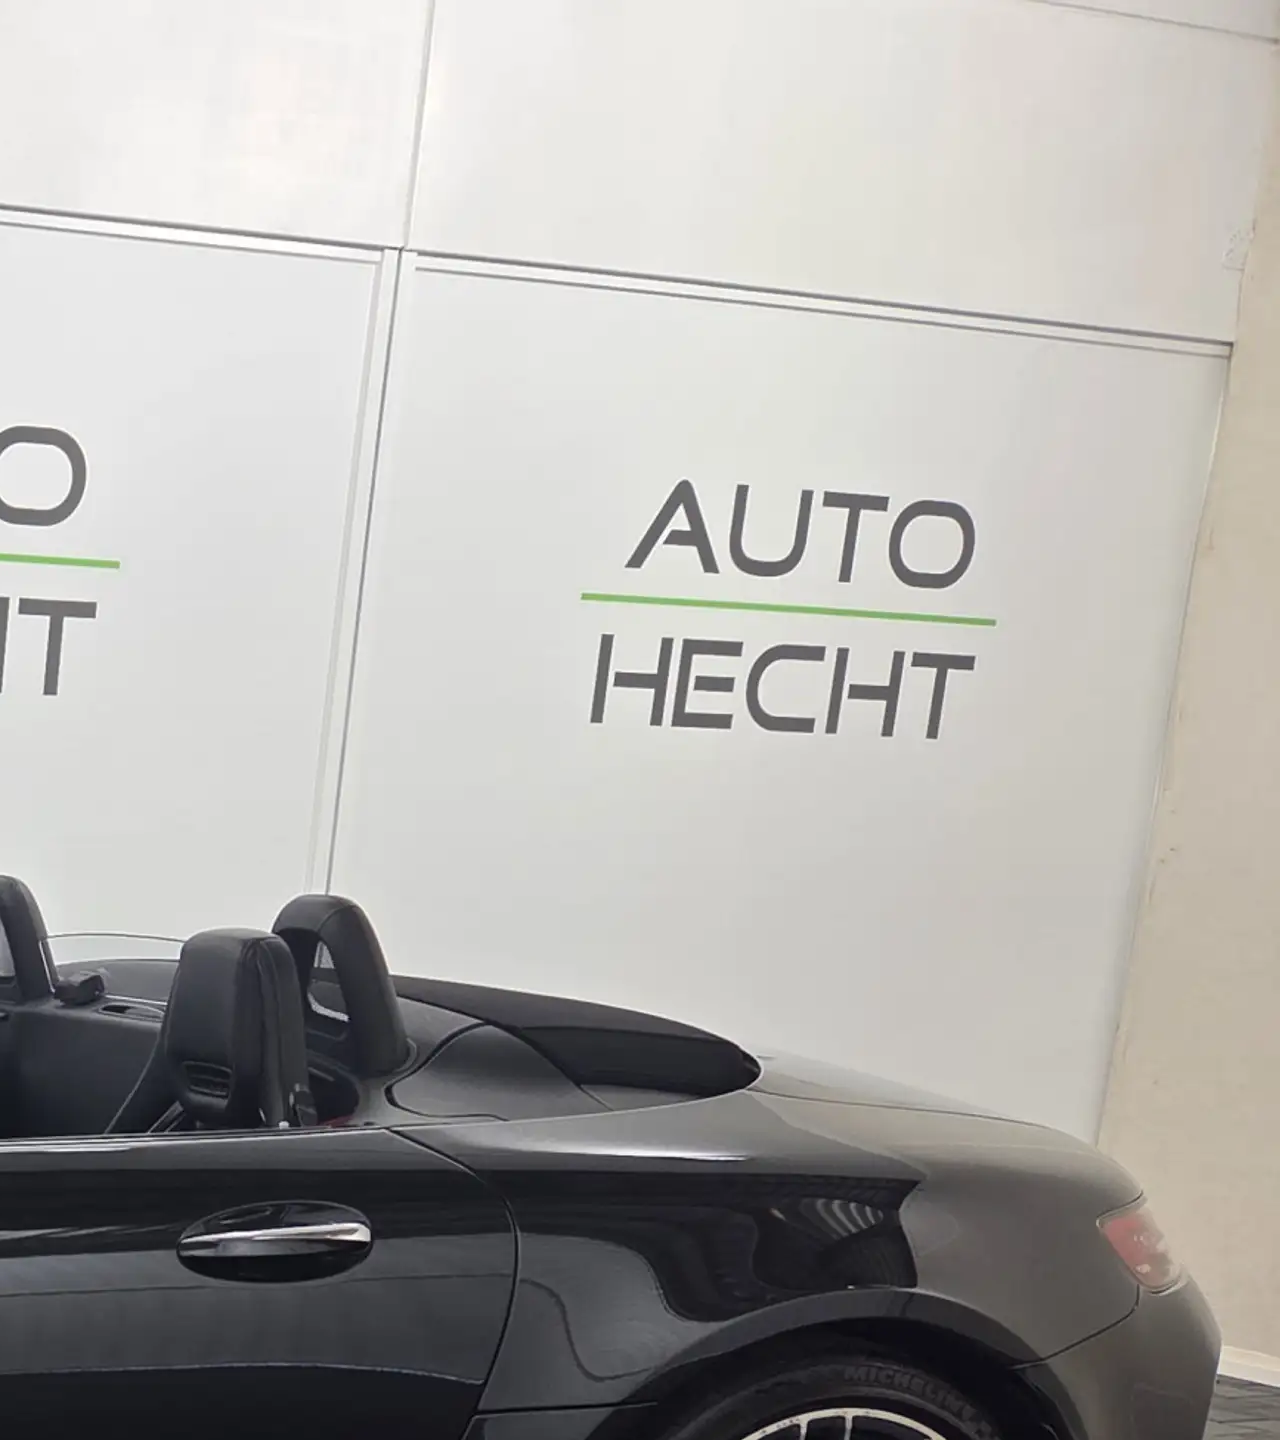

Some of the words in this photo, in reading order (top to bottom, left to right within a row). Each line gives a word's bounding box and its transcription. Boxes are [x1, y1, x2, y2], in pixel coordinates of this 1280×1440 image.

[624, 479, 976, 589] AUTO
[590, 633, 976, 740] HECHT
[843, 1366, 963, 1414] MICHELIN
